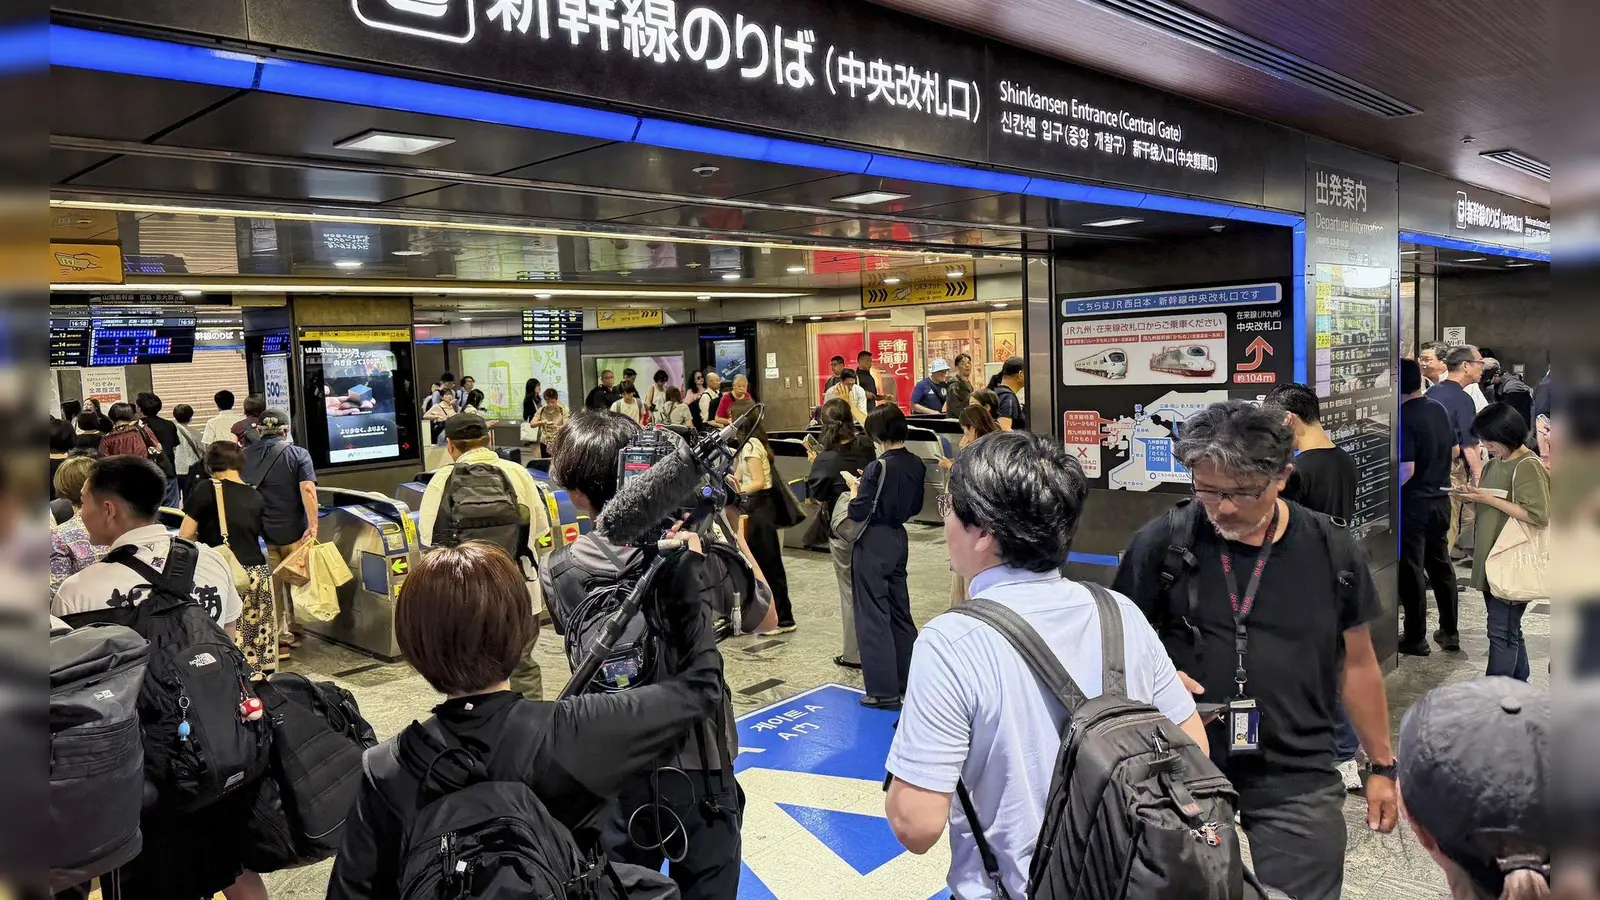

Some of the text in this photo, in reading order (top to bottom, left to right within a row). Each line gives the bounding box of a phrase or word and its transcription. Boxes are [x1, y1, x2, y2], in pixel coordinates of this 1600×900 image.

[999, 80, 1069, 117] Shinkansen
[1157, 121, 1182, 143] Gate)
[1000, 110, 1036, 138] 신칸센
[1094, 131, 1126, 156] 개찰구)
[1315, 170, 1367, 212] 出発案内
[1315, 212, 1384, 236] Departure Information
[1076, 289, 1260, 312] こちらはJR西日本・新幹線中央改札口です
[1065, 318, 1222, 335] JR九州・在来線改札口からご乗車ください
[1236, 310, 1281, 320] 在来線(JR九州)
[1236, 321, 1282, 332] 中央改札口
[878, 340, 894, 369] 幸福。
[266, 382, 280, 397] 500
[1237, 374, 1273, 383] 約104m
[750, 703, 824, 733] 게이트 A
